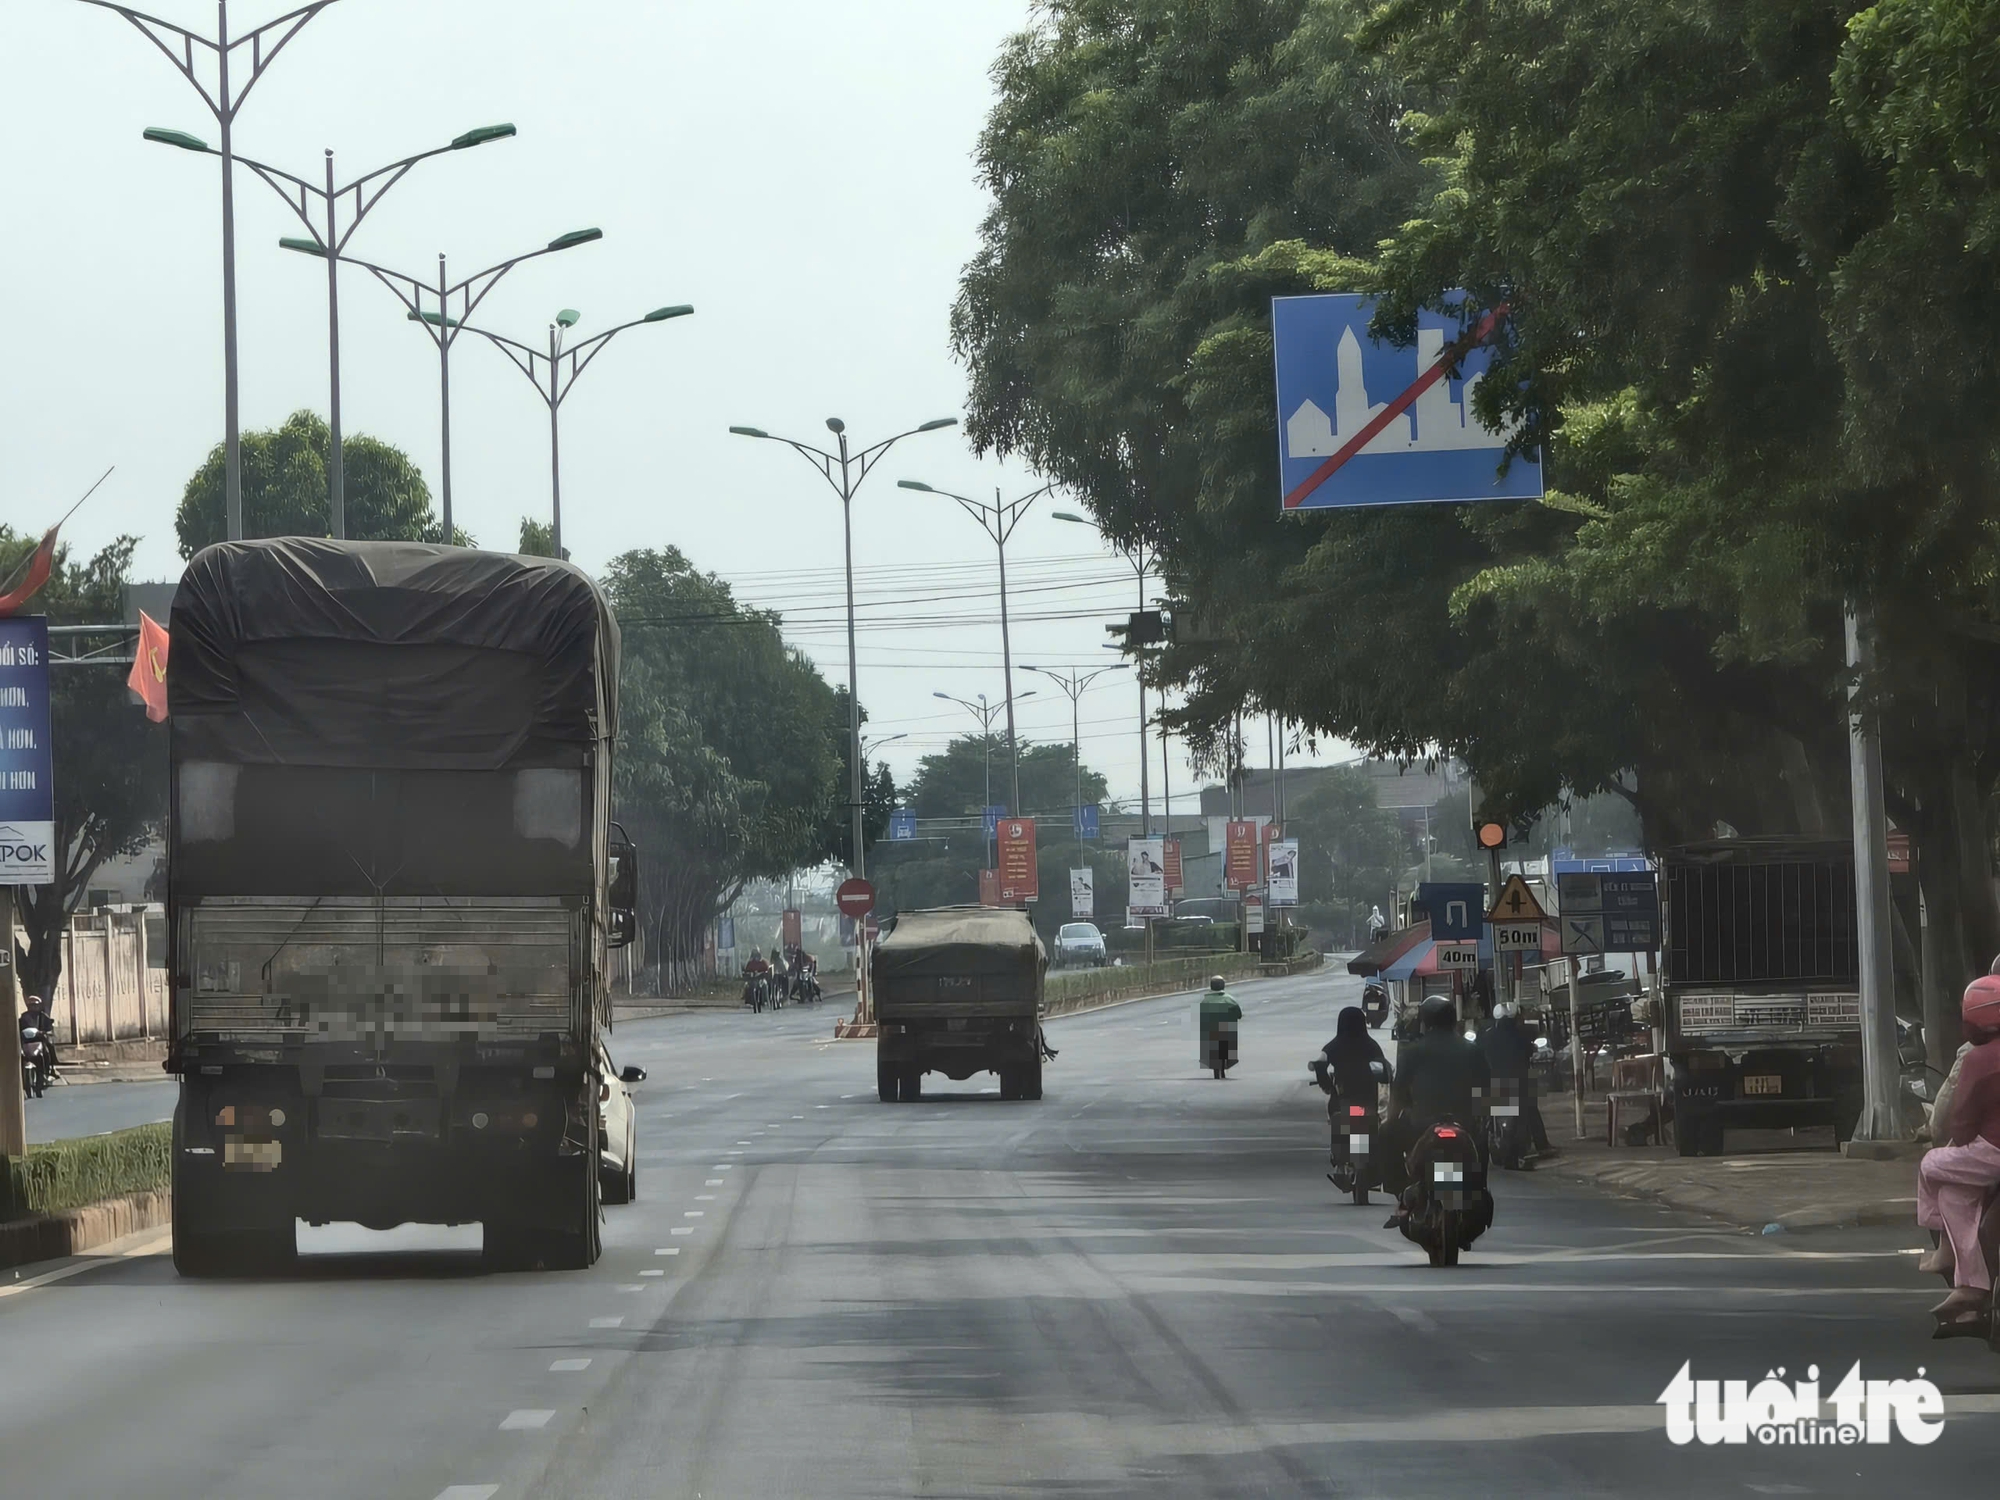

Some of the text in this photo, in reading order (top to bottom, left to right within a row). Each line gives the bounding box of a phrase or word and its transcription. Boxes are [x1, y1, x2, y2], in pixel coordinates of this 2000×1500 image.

[11, 770, 36, 790] HƠN
[0, 844, 47, 862] POK
[1500, 930, 1538, 944] 50m
[1443, 951, 1476, 963] 40m
